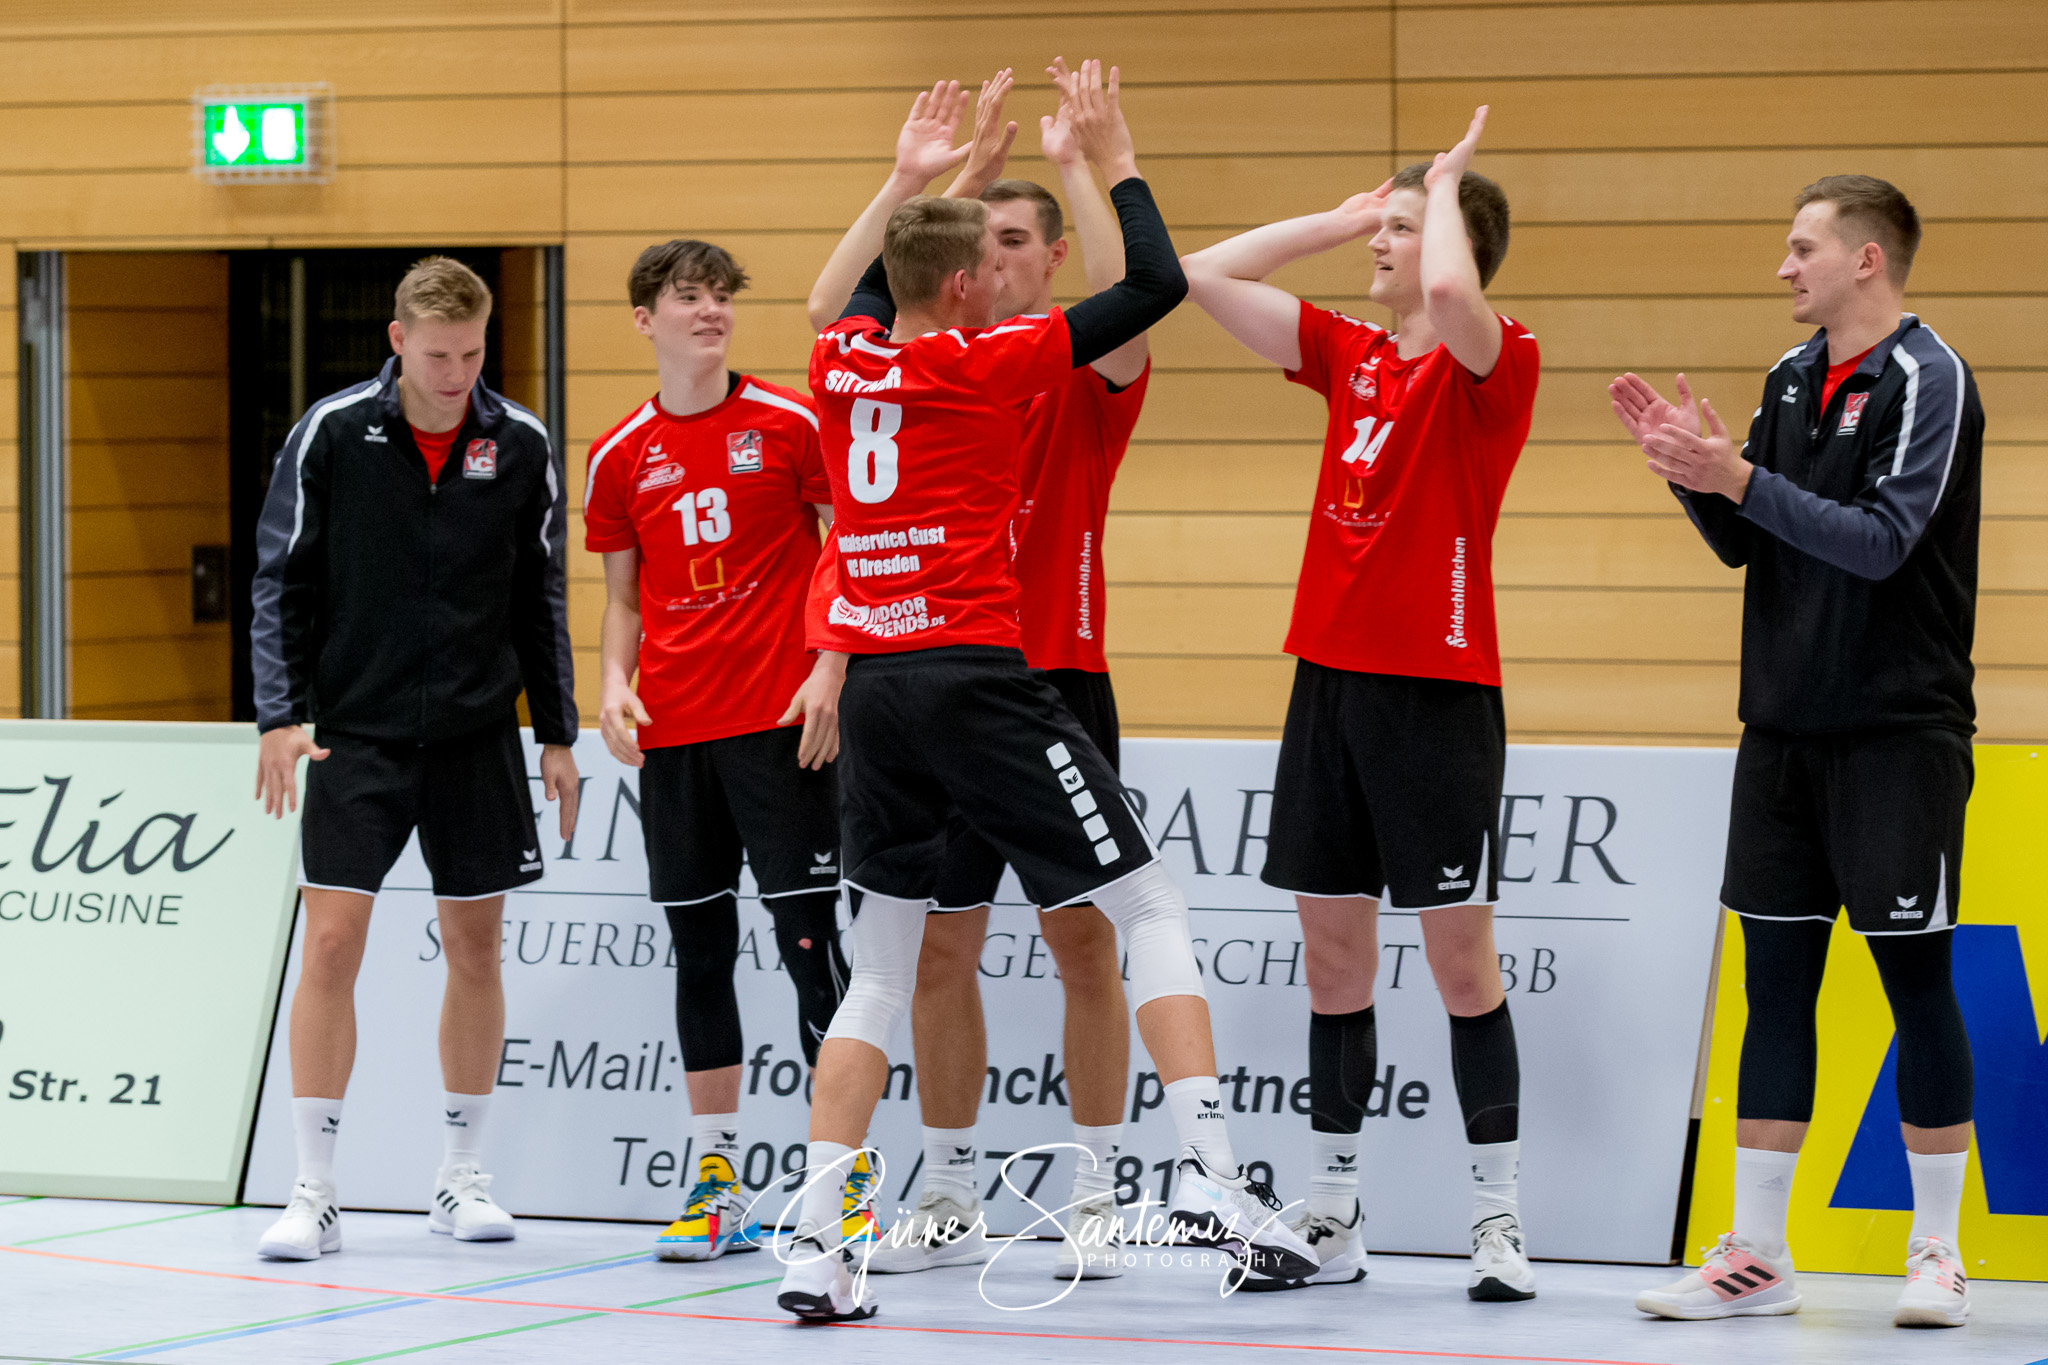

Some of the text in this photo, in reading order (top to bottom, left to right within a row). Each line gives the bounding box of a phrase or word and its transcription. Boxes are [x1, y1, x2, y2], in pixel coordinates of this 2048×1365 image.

[848, 397, 903, 504] 8
[1341, 415, 1395, 469] 14
[466, 455, 494, 472] VC
[730, 448, 760, 466] VC
[672, 487, 732, 547] 13
[908, 526, 946, 546] Gust
[859, 554, 921, 578] Dresden
[1437, 878, 1471, 891] erima
[0, 890, 183, 925] CUISINE
[1889, 908, 1924, 920] erima
[496, 1038, 677, 1093] E-Mail:
[9, 1069, 162, 1105] Str. 21
